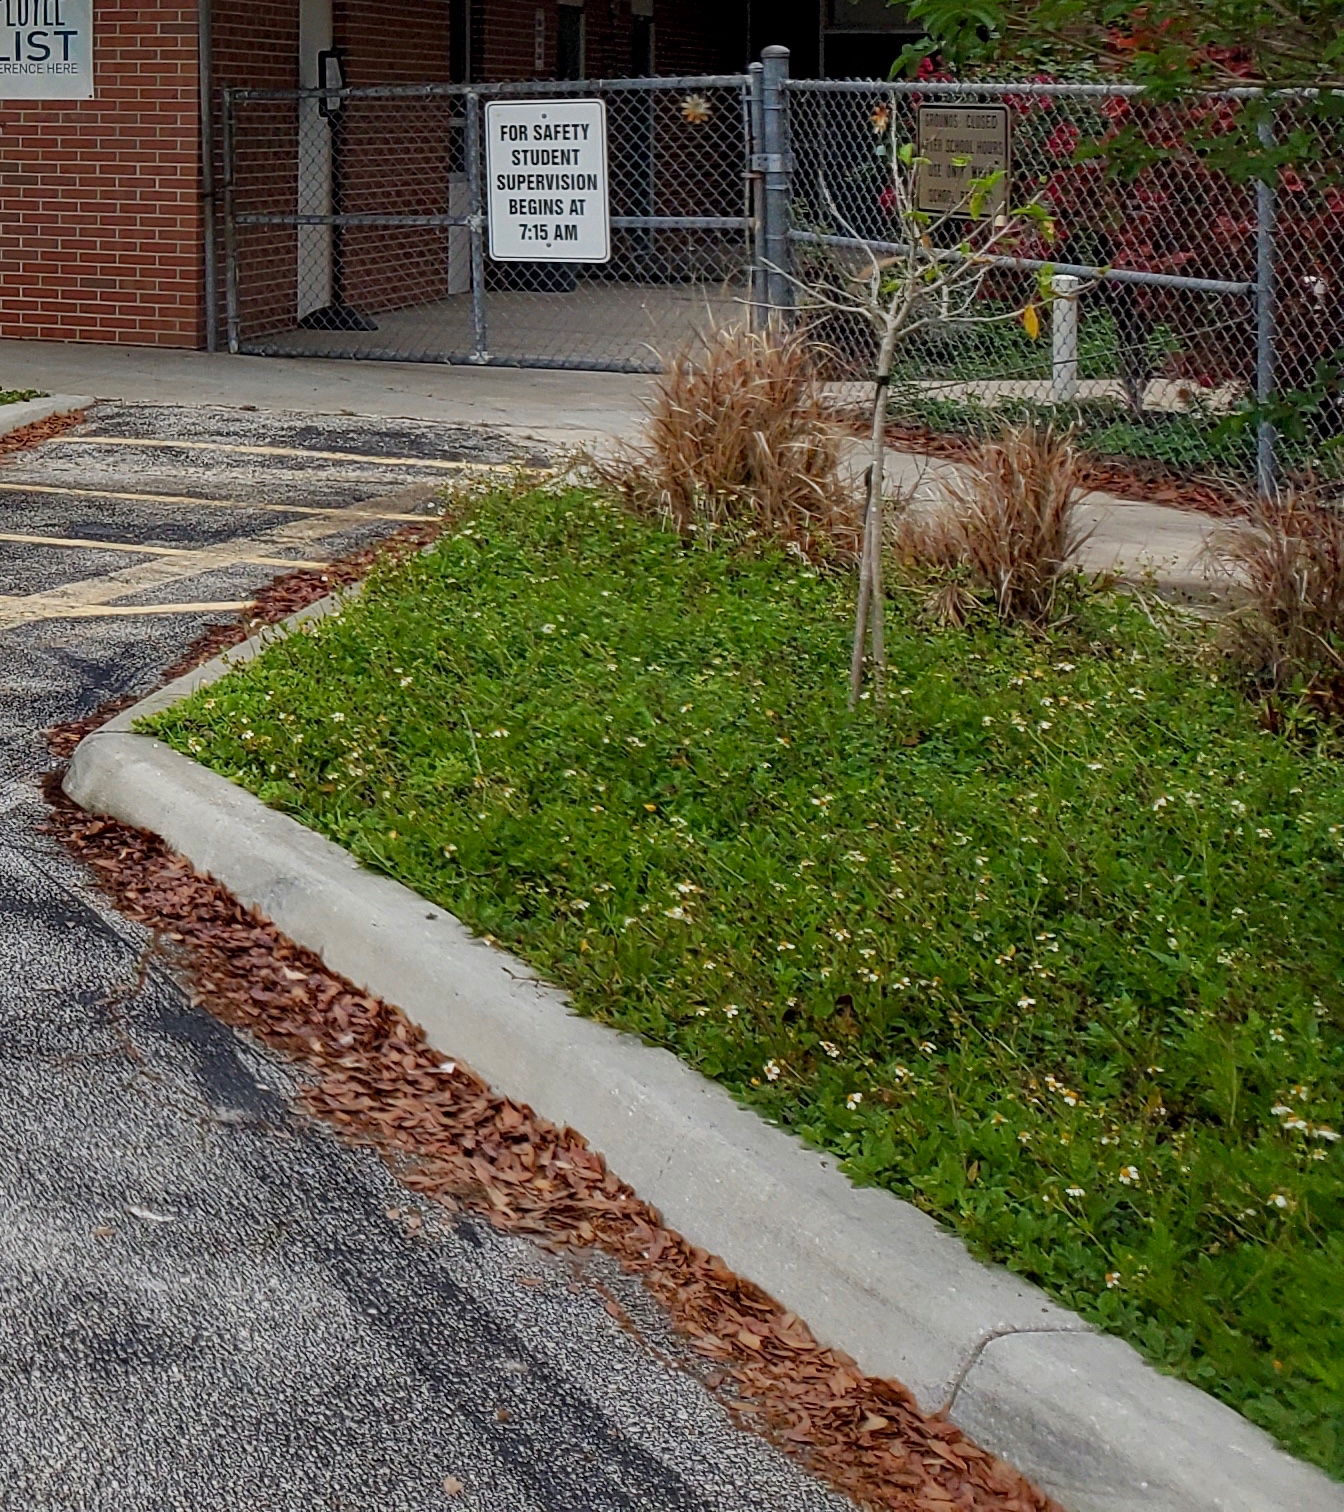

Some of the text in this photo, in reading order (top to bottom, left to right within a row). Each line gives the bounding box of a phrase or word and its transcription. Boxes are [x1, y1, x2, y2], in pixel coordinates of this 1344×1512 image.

[47, 62, 79, 74] HERE
[500, 123, 590, 142] FOR SAFETY
[511, 149, 580, 166] STUDENT
[496, 173, 598, 191] SUPERVISION
[508, 198, 586, 216] BEGINS AT
[518, 223, 578, 241] 7:15 AM
